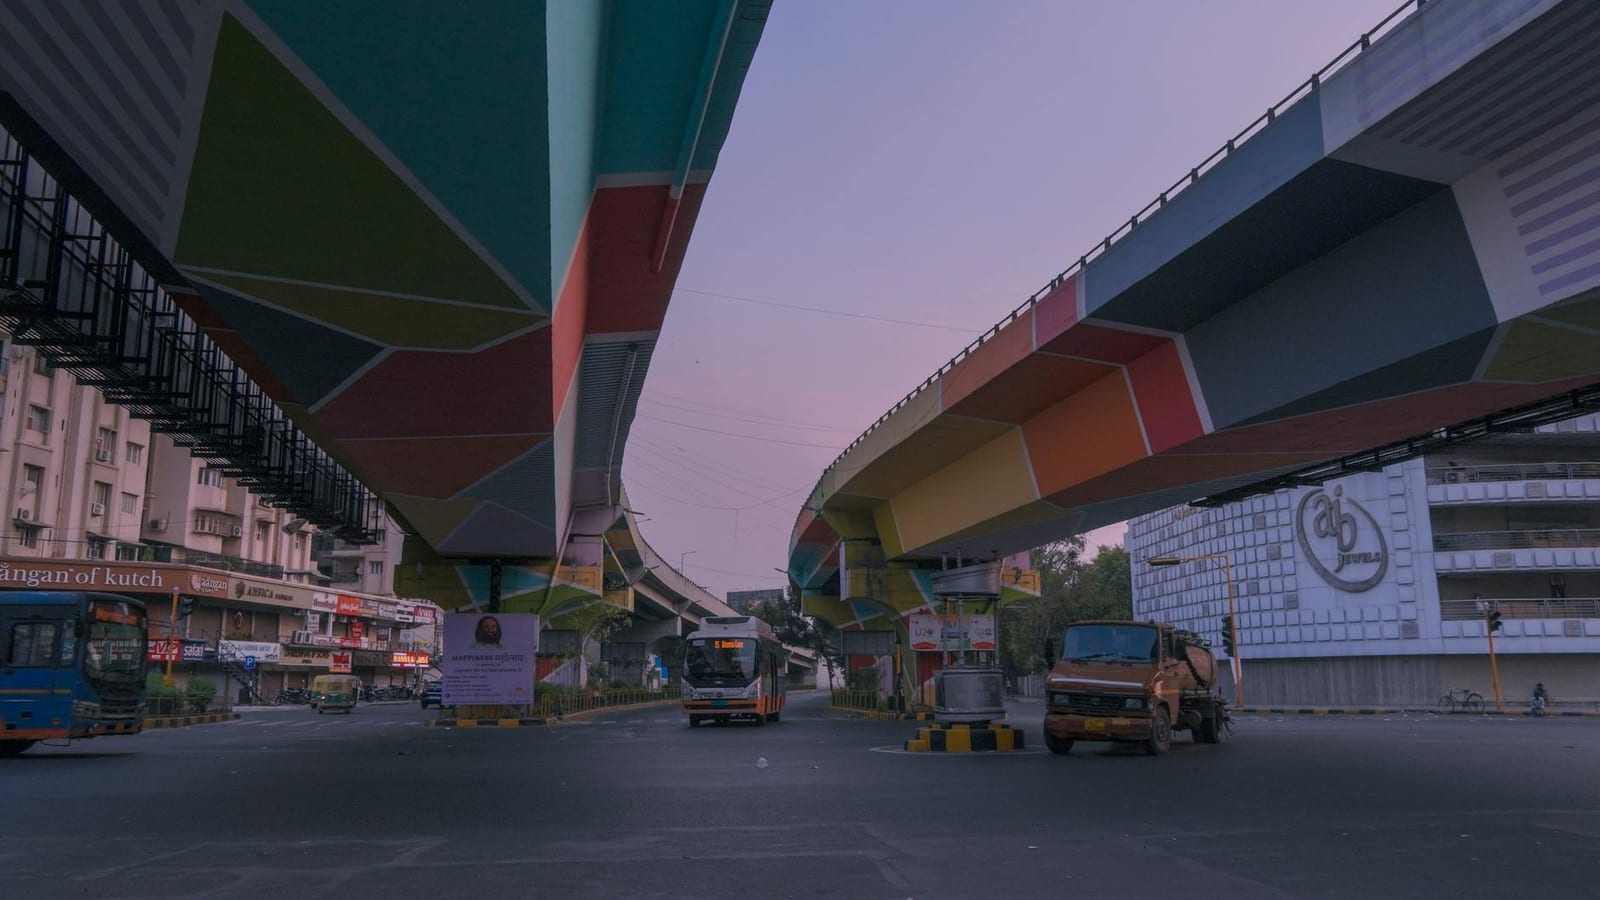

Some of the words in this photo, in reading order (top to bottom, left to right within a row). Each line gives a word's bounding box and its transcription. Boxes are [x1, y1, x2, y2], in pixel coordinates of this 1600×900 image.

[75, 568, 101, 585] of
[104, 568, 163, 587] kutch
[183, 643, 204, 657] safari
[246, 657, 253, 667] P
